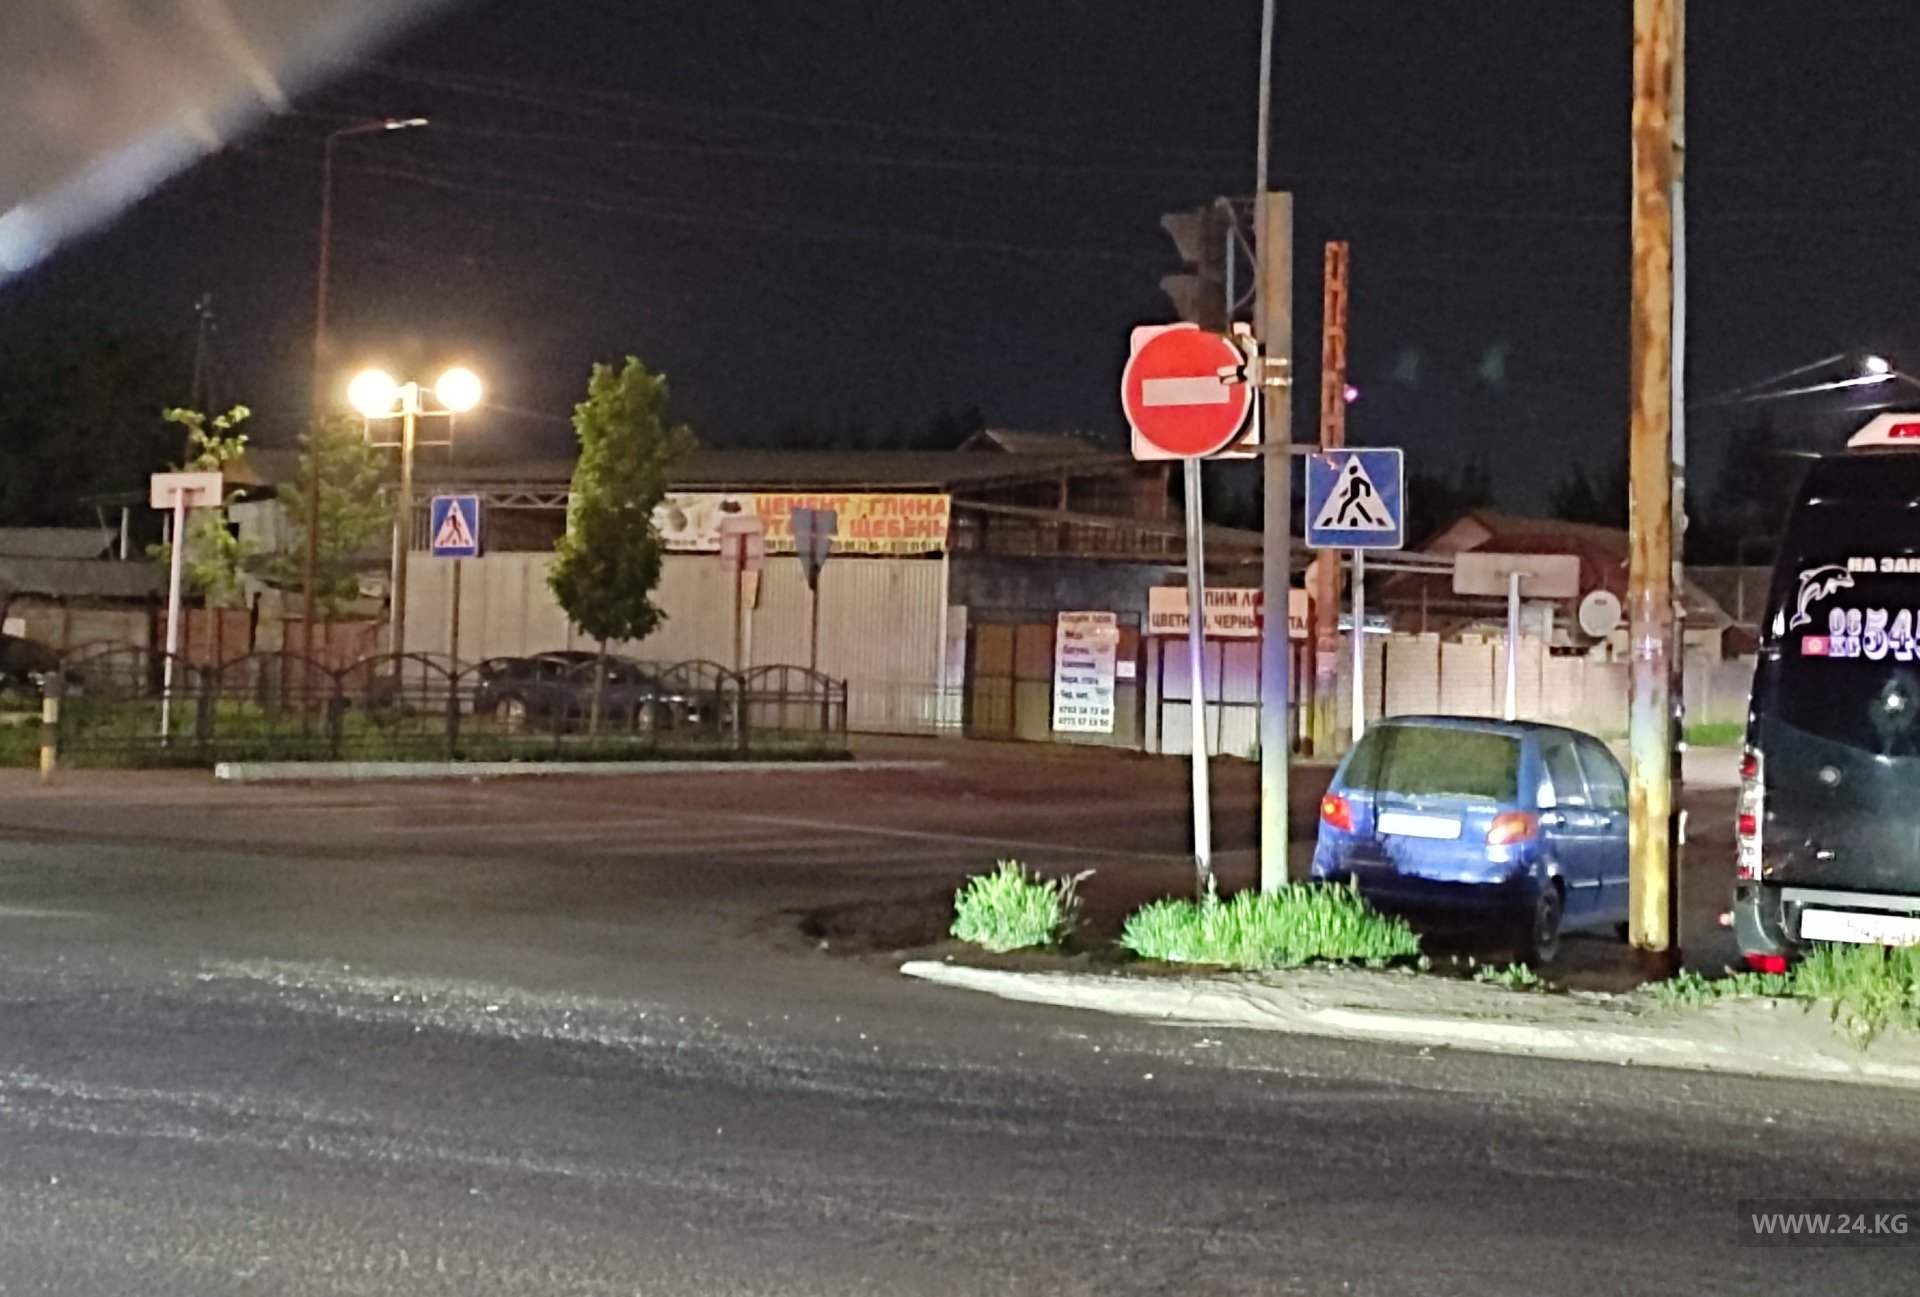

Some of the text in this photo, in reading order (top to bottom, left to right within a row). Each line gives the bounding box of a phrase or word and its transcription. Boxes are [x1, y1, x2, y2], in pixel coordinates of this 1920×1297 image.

[756, 497, 850, 514] ЦЕМЕНТ
[870, 497, 946, 515] ГЛИНА
[1847, 556, 1877, 572] НА
[1187, 591, 1238, 607] ПИМ
[1862, 606, 1920, 661] 54
